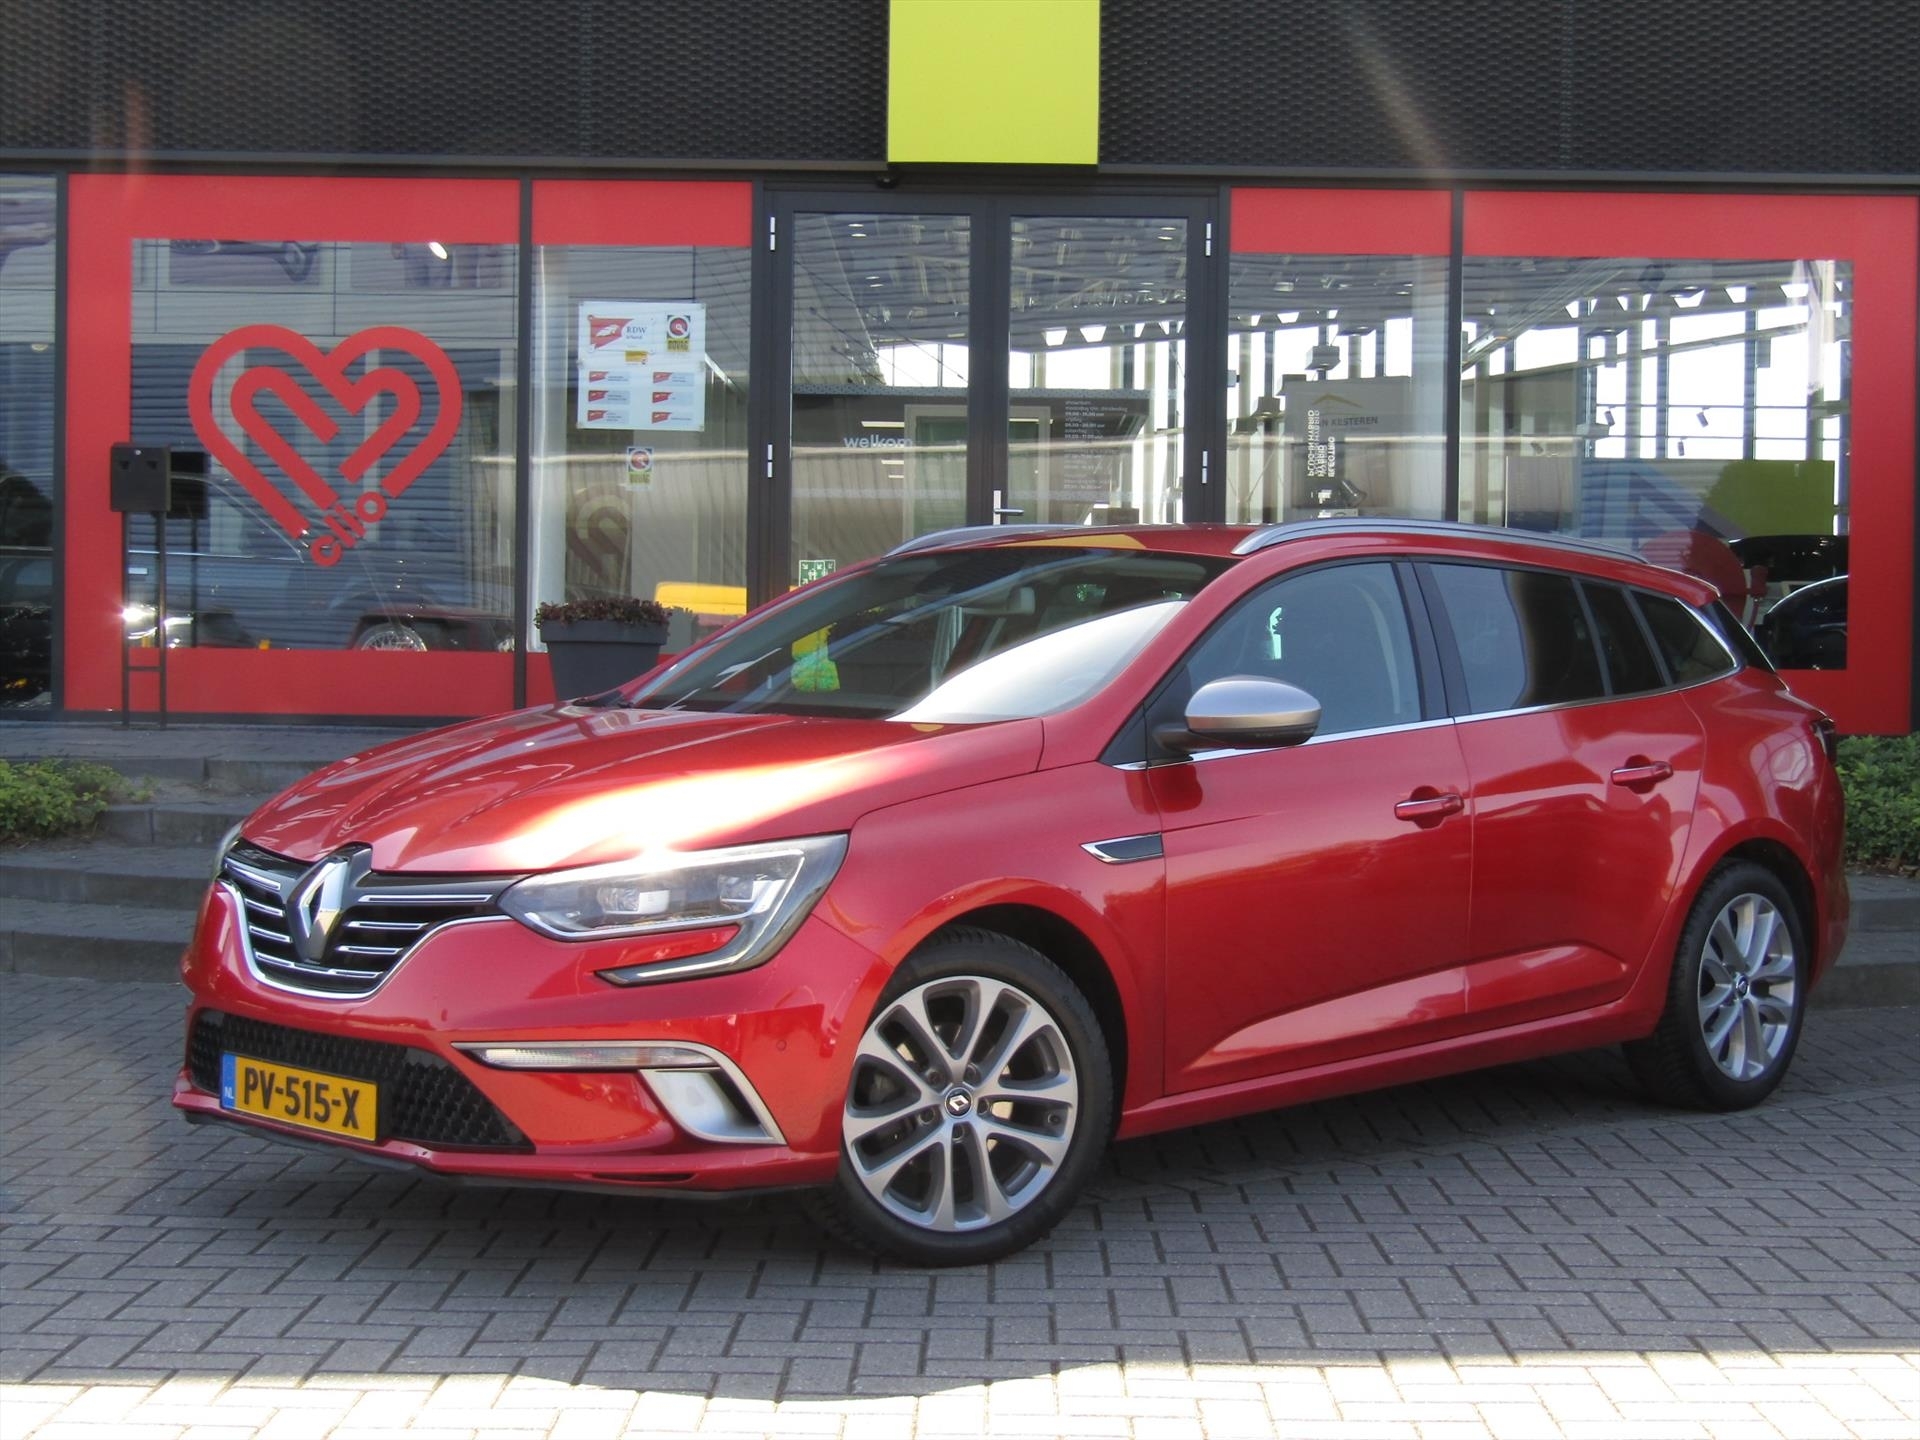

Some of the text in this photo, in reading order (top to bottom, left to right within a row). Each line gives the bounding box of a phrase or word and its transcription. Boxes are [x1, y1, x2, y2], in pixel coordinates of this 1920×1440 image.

[1331, 416, 1378, 426] KESTEREN
[843, 434, 913, 448] welkom
[310, 491, 388, 567] clio
[224, 1066, 360, 1130] NL PV-515-X
